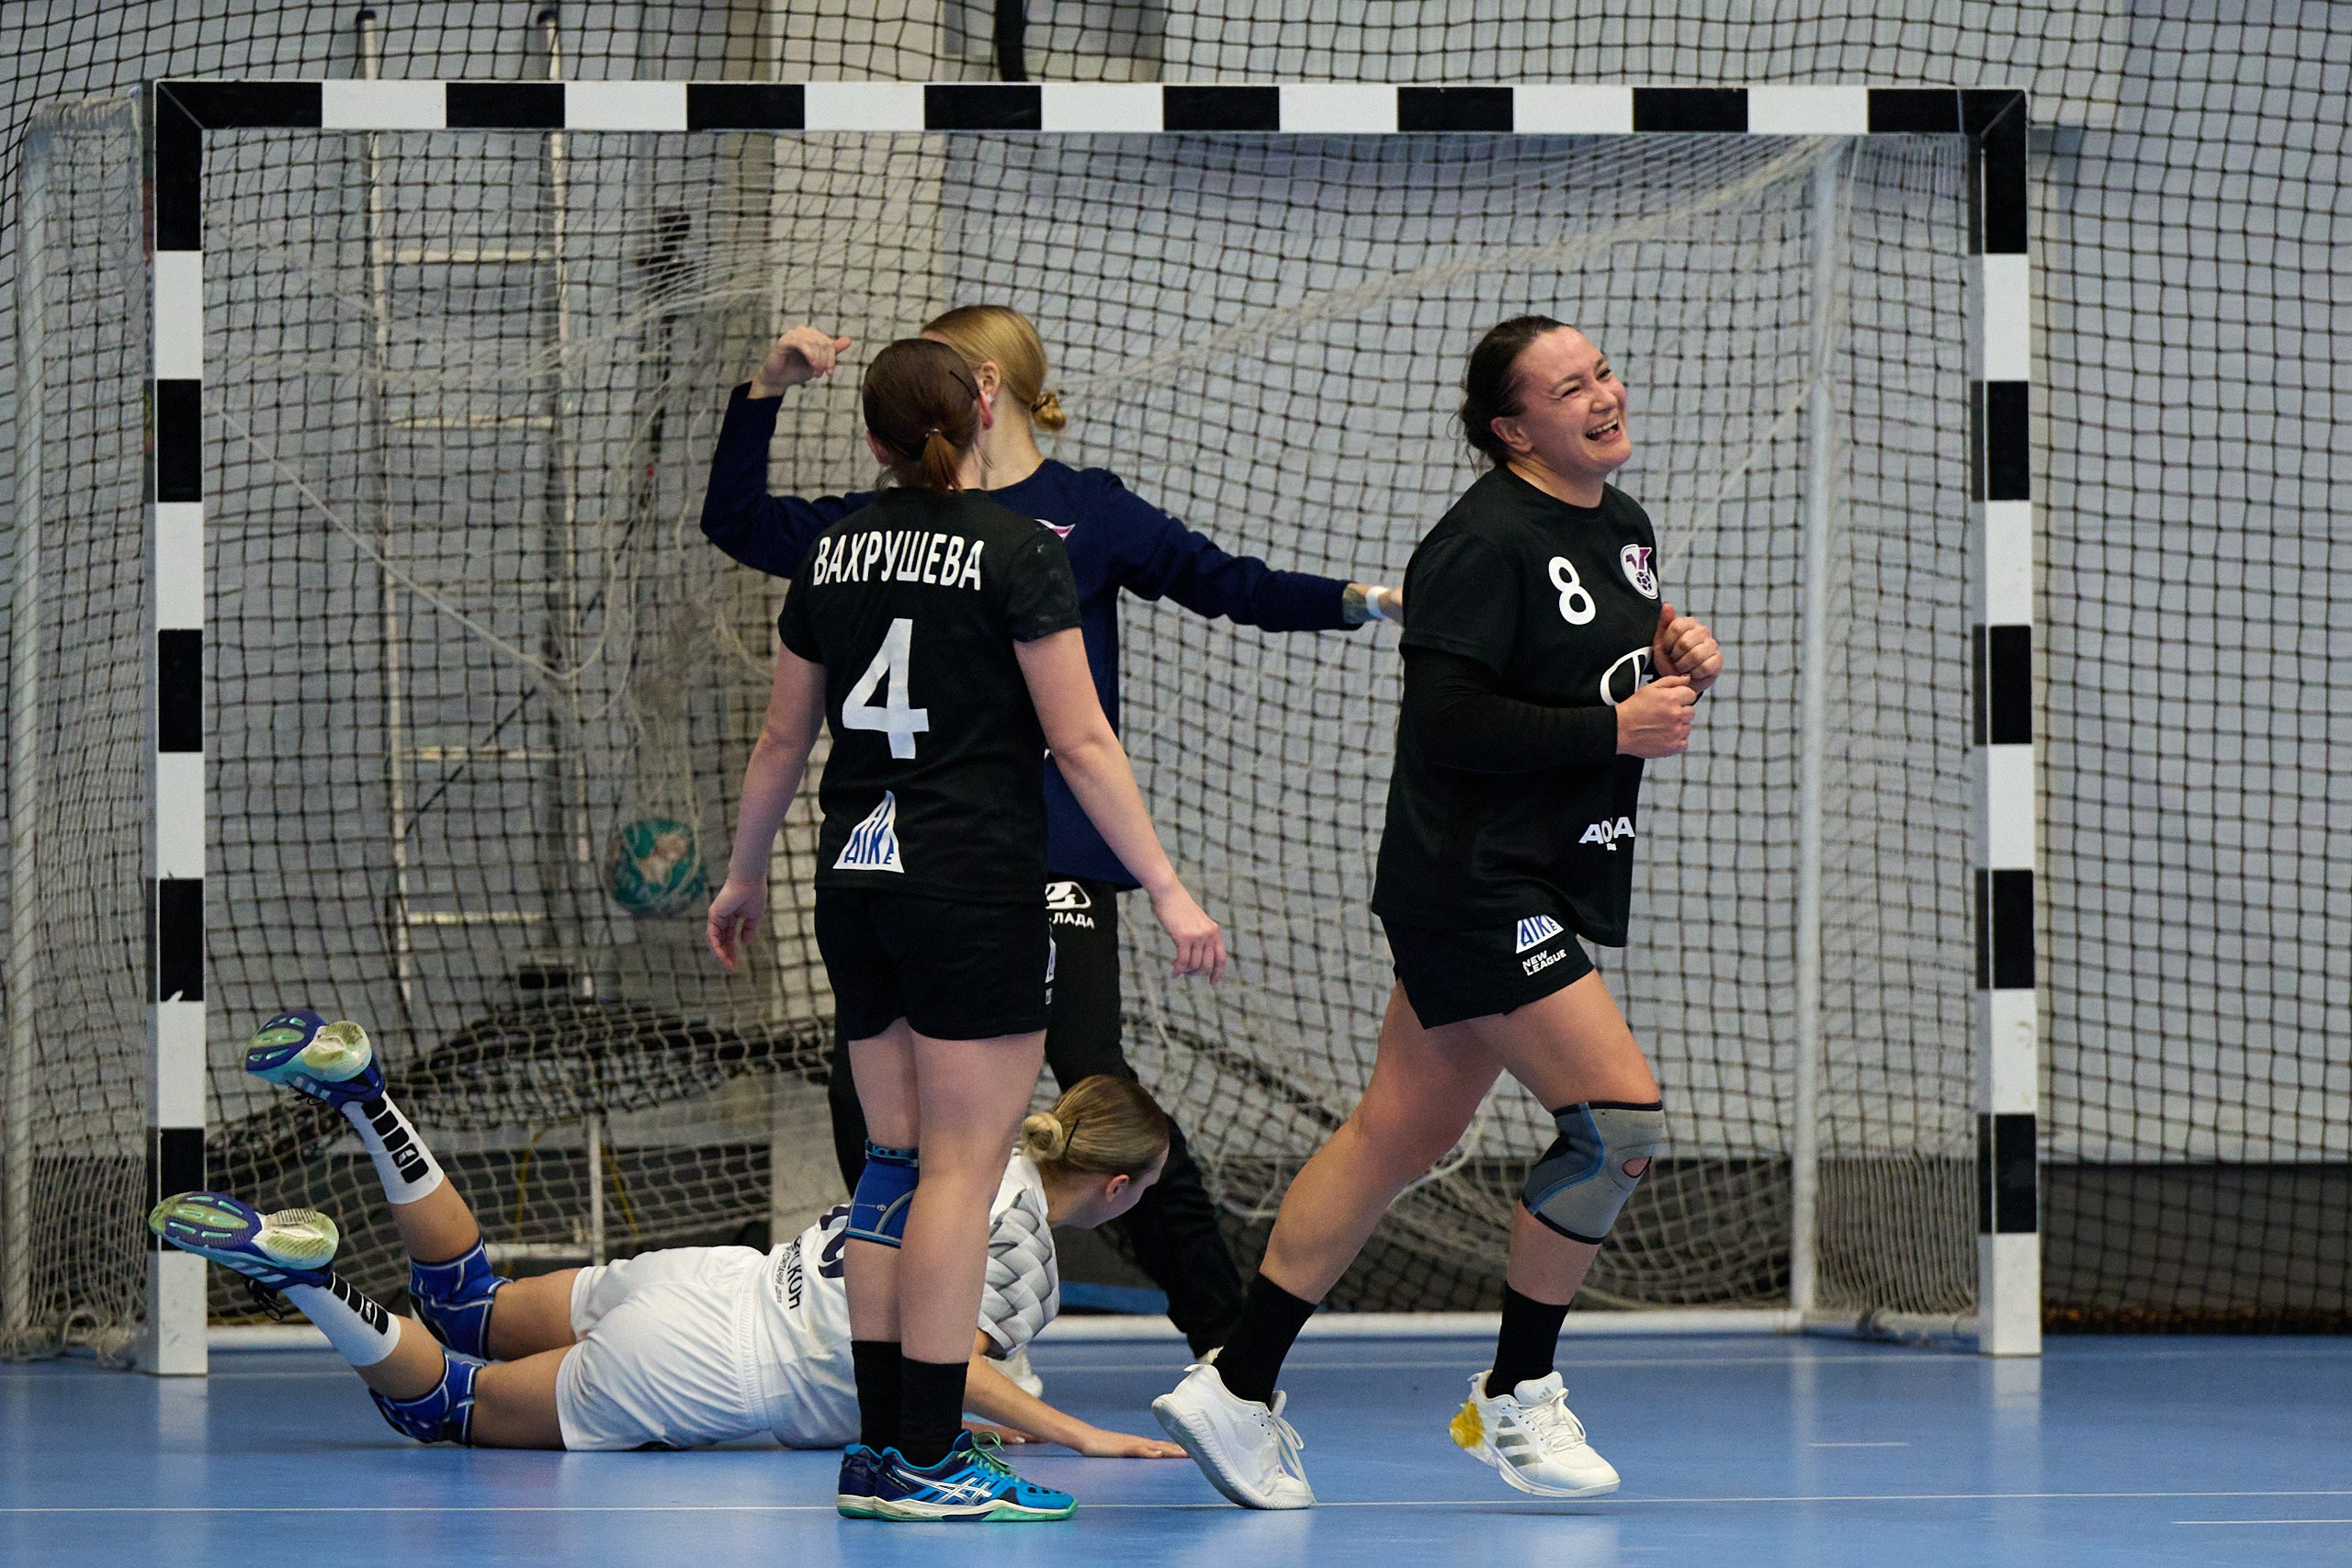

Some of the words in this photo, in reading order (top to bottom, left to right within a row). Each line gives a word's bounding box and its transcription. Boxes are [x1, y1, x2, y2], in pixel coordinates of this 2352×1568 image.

[813, 530, 985, 591] ВАХРУШЕВА
[1549, 556, 1596, 626] 8
[842, 618, 929, 759] 4
[1521, 950, 1547, 967] NEW
[1524, 949, 1567, 976] LEAGUE
